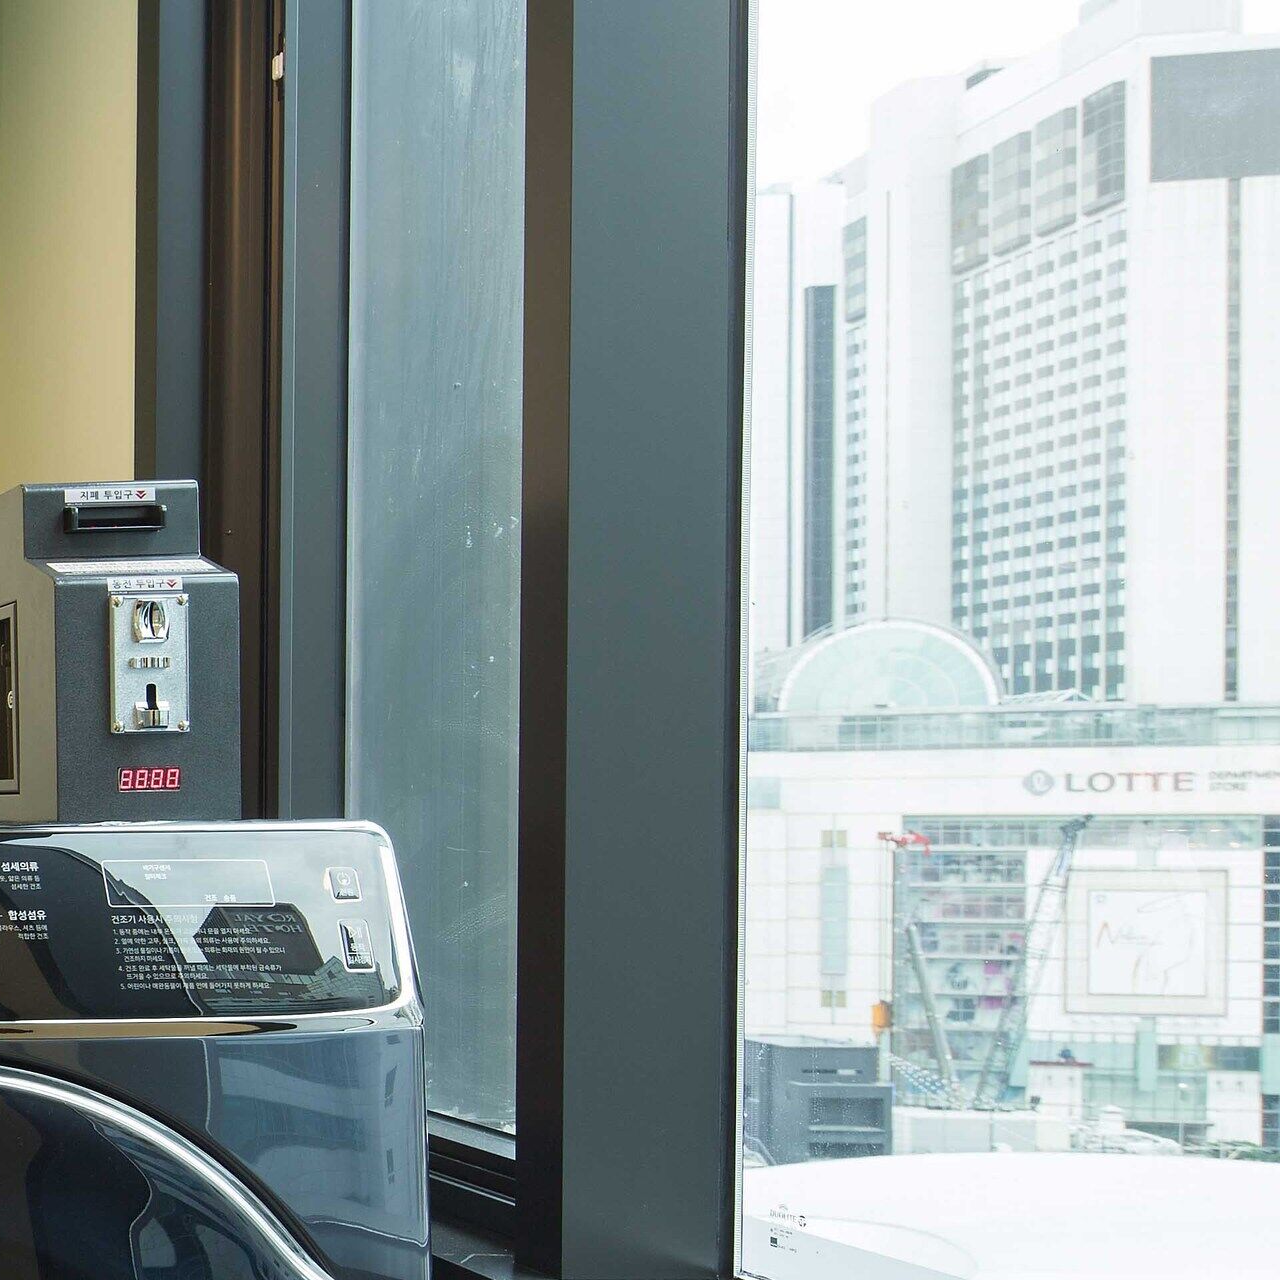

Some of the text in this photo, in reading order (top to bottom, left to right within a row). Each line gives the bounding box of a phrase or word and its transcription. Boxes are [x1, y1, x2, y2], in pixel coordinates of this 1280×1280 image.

[80, 490, 133, 500] 지폐 투입구
[112, 579, 165, 589] 동전 투입구
[1065, 772, 1195, 792] LOTTE
[0, 861, 39, 872] 섬세의류
[7, 910, 47, 921] 합성섬유
[111, 914, 136, 925] 건조기
[138, 914, 164, 925] 사용시
